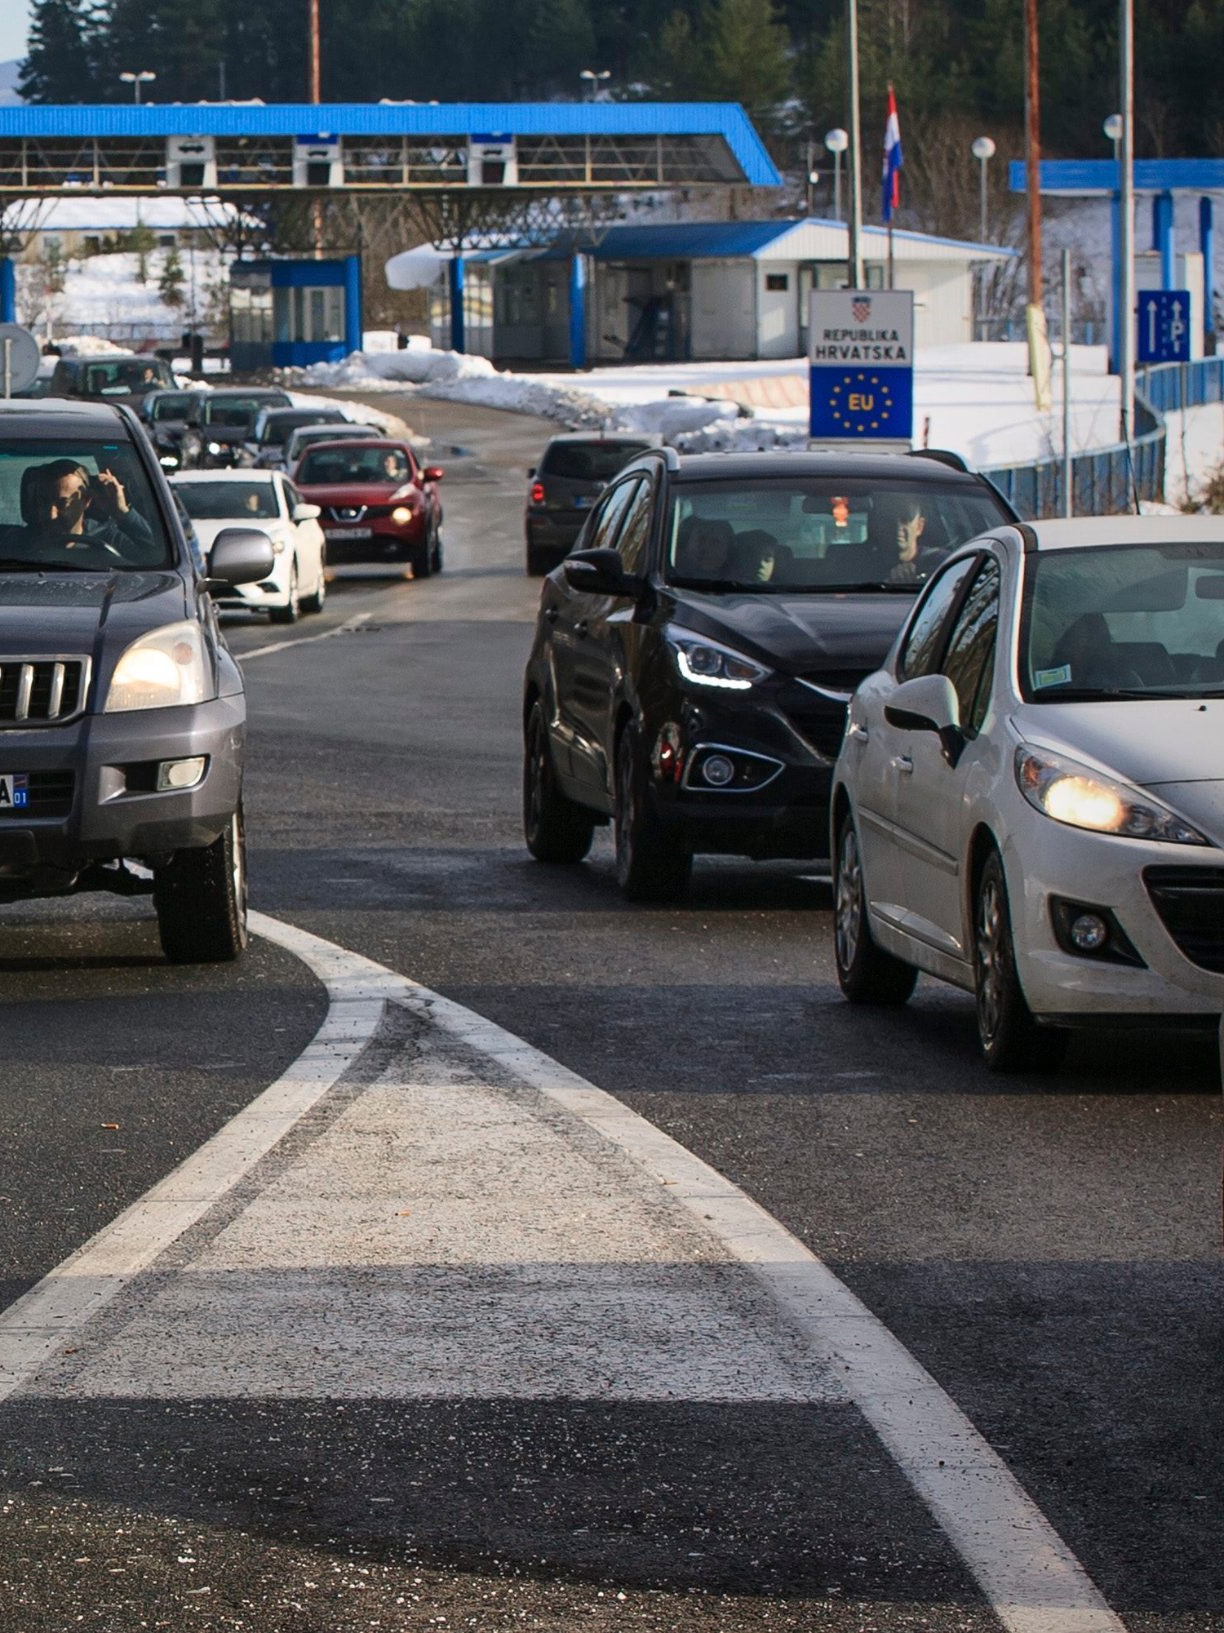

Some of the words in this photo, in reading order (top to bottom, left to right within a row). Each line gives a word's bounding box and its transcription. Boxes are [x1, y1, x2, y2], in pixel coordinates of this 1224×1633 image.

[823, 329, 899, 341] REPUBLIKA
[1171, 320, 1184, 341] P
[816, 345, 906, 360] HRVATSKA
[848, 394, 874, 411] EU
[14, 792, 27, 804] 01
